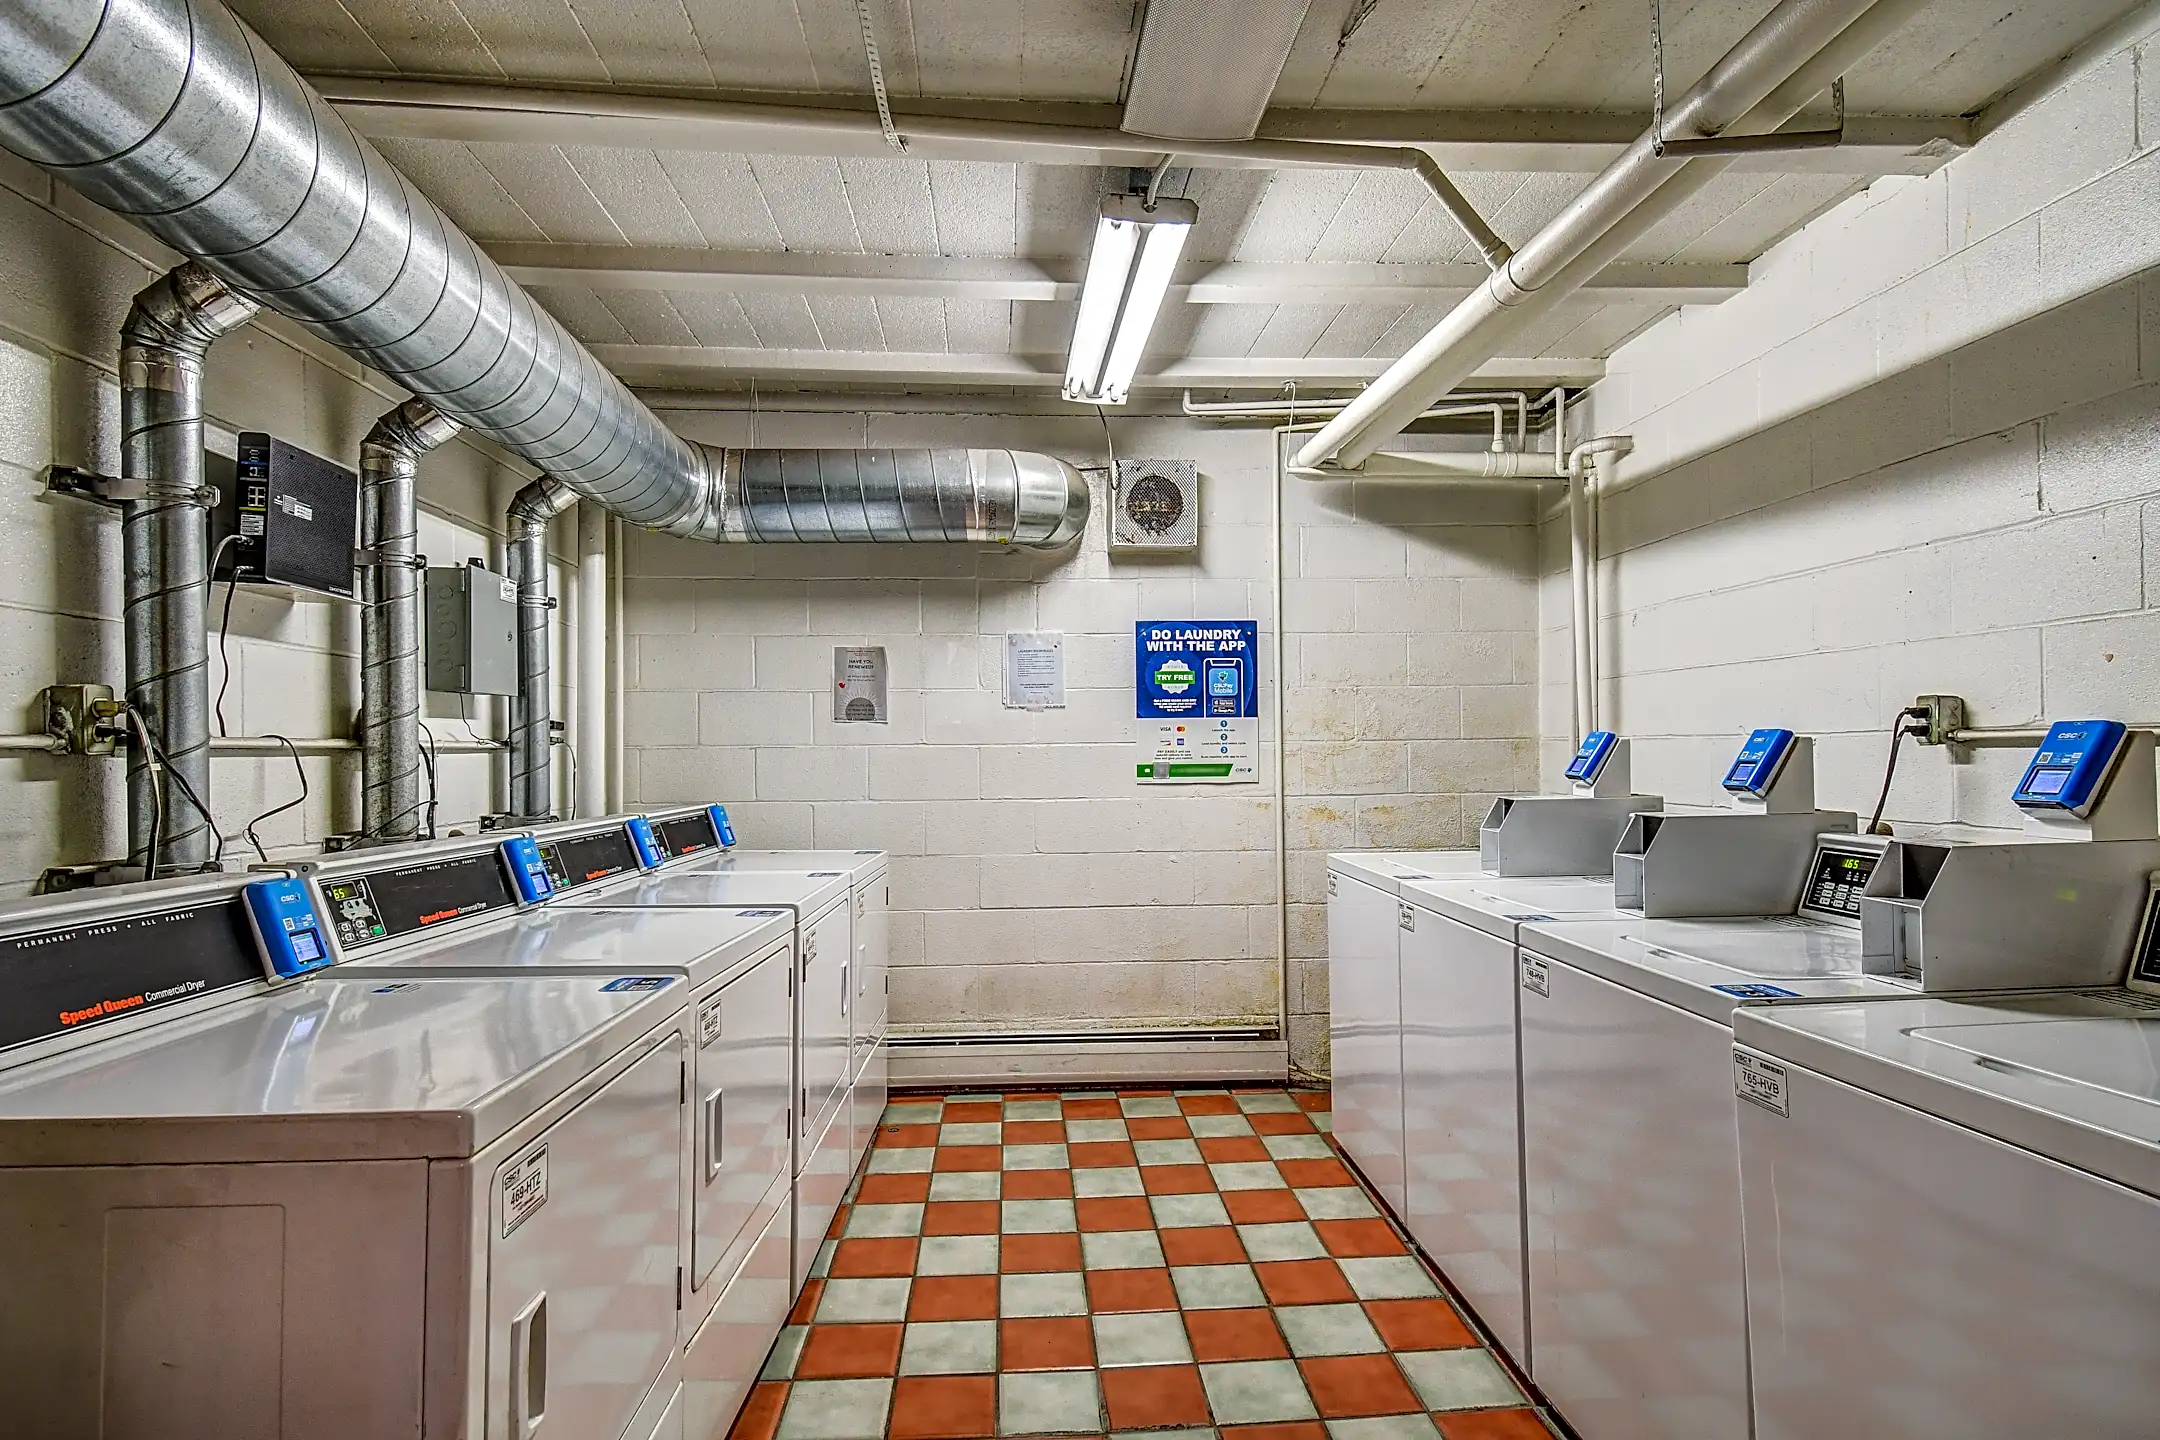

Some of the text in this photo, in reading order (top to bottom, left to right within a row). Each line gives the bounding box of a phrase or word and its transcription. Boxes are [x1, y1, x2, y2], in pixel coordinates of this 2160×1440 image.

[1151, 629, 1241, 640] DO LAUNDRY
[1146, 641, 1246, 651] WITH THE APP
[281, 894, 295, 902] CSC
[333, 888, 345, 899] 65
[16, 912, 194, 949] PERMANENT PRESS ALL FABRIC
[59, 979, 206, 1025] Speed Queen Commercial Dryer
[1735, 1053, 1748, 1064] CSC
[1742, 1070, 1780, 1095] 765-HVB
[510, 1171, 541, 1206] 469-HTZ
